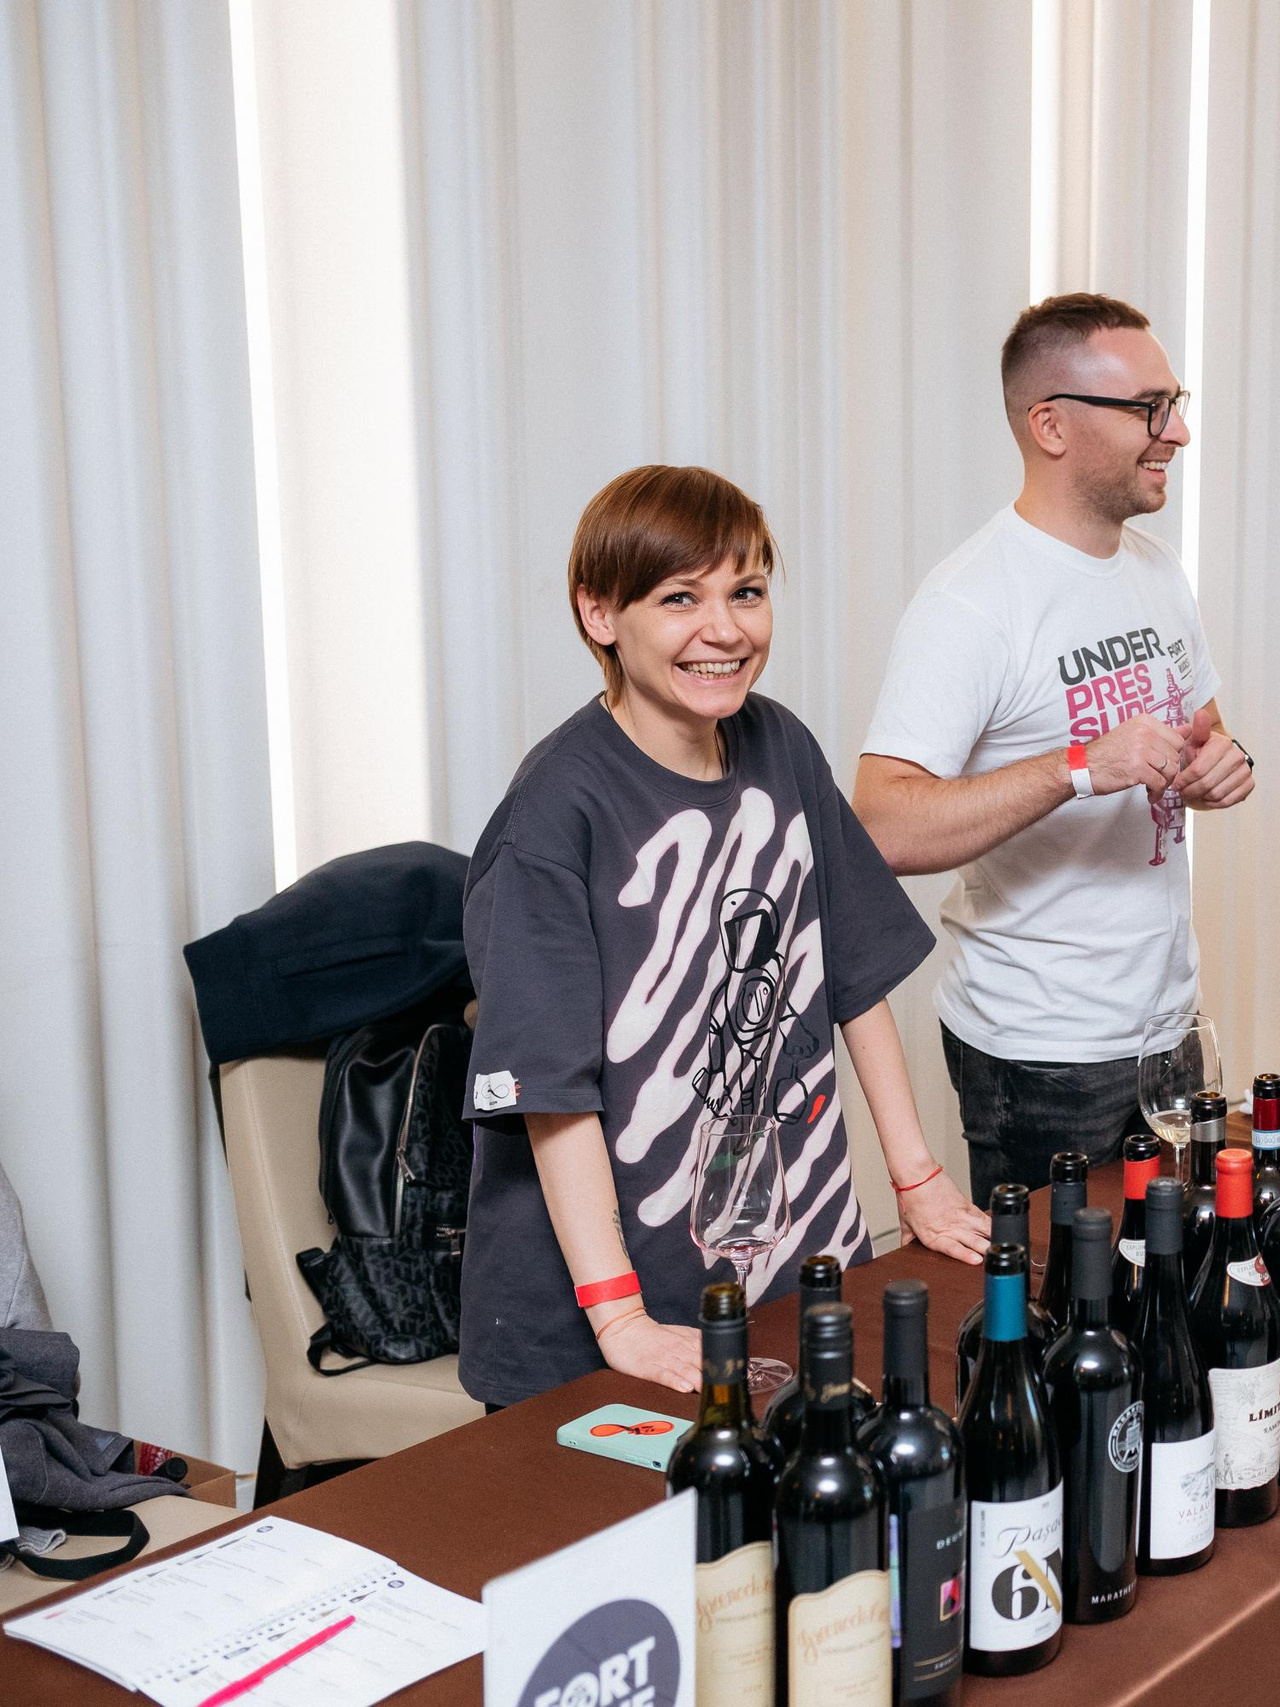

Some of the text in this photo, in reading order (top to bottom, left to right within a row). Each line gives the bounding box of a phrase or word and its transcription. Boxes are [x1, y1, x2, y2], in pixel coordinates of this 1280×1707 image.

[1058, 627, 1166, 686] UNDER
[1167, 639, 1185, 658] FORT
[1066, 663, 1152, 721] PRES
